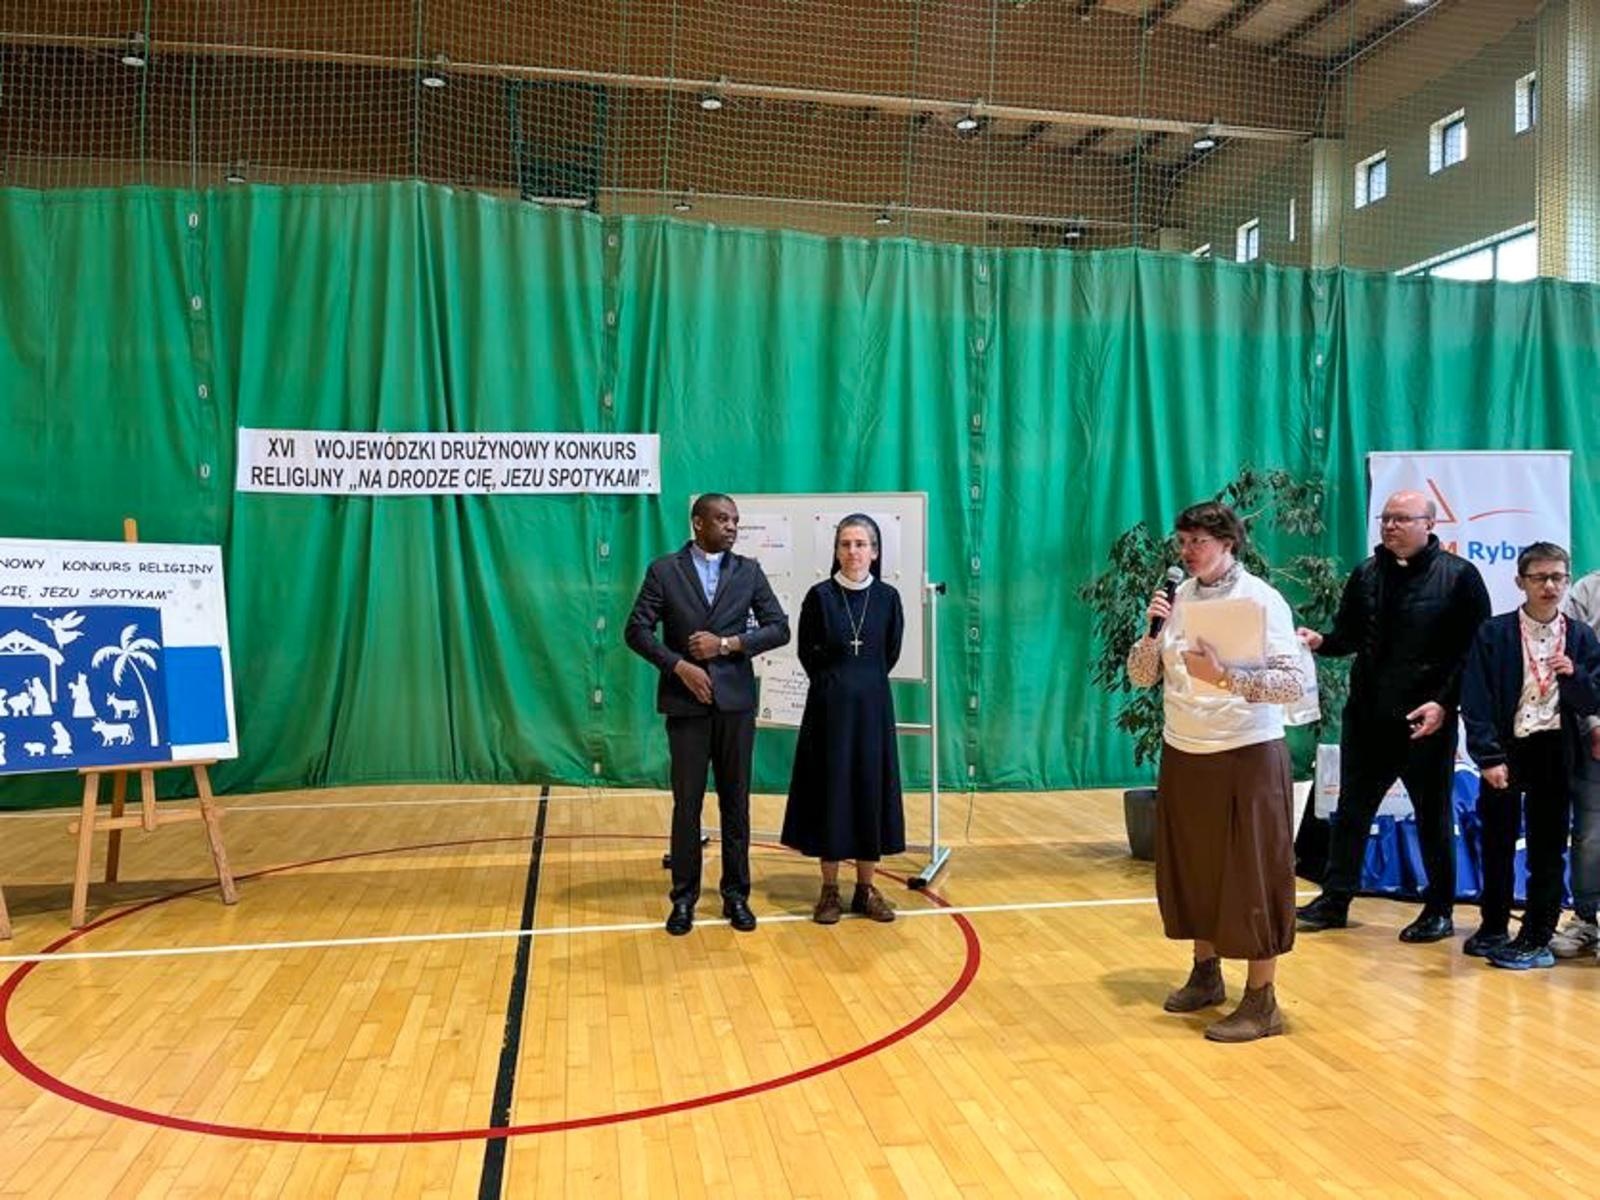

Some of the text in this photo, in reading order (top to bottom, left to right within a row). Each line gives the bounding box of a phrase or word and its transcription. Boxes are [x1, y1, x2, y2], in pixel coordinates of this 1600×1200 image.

[267, 435, 637, 460] XVI WOJEWÓDZKI DRUŻYNOWY KONKURS
[251, 466, 344, 487] RELIGIJNY
[387, 468, 460, 489] DRODZE
[464, 468, 497, 492] CIĘ,
[500, 468, 545, 488] JEZU
[62, 559, 131, 572] KONKURS
[139, 562, 214, 574] RELIGIJNY
[39, 586, 80, 598] JEZU
